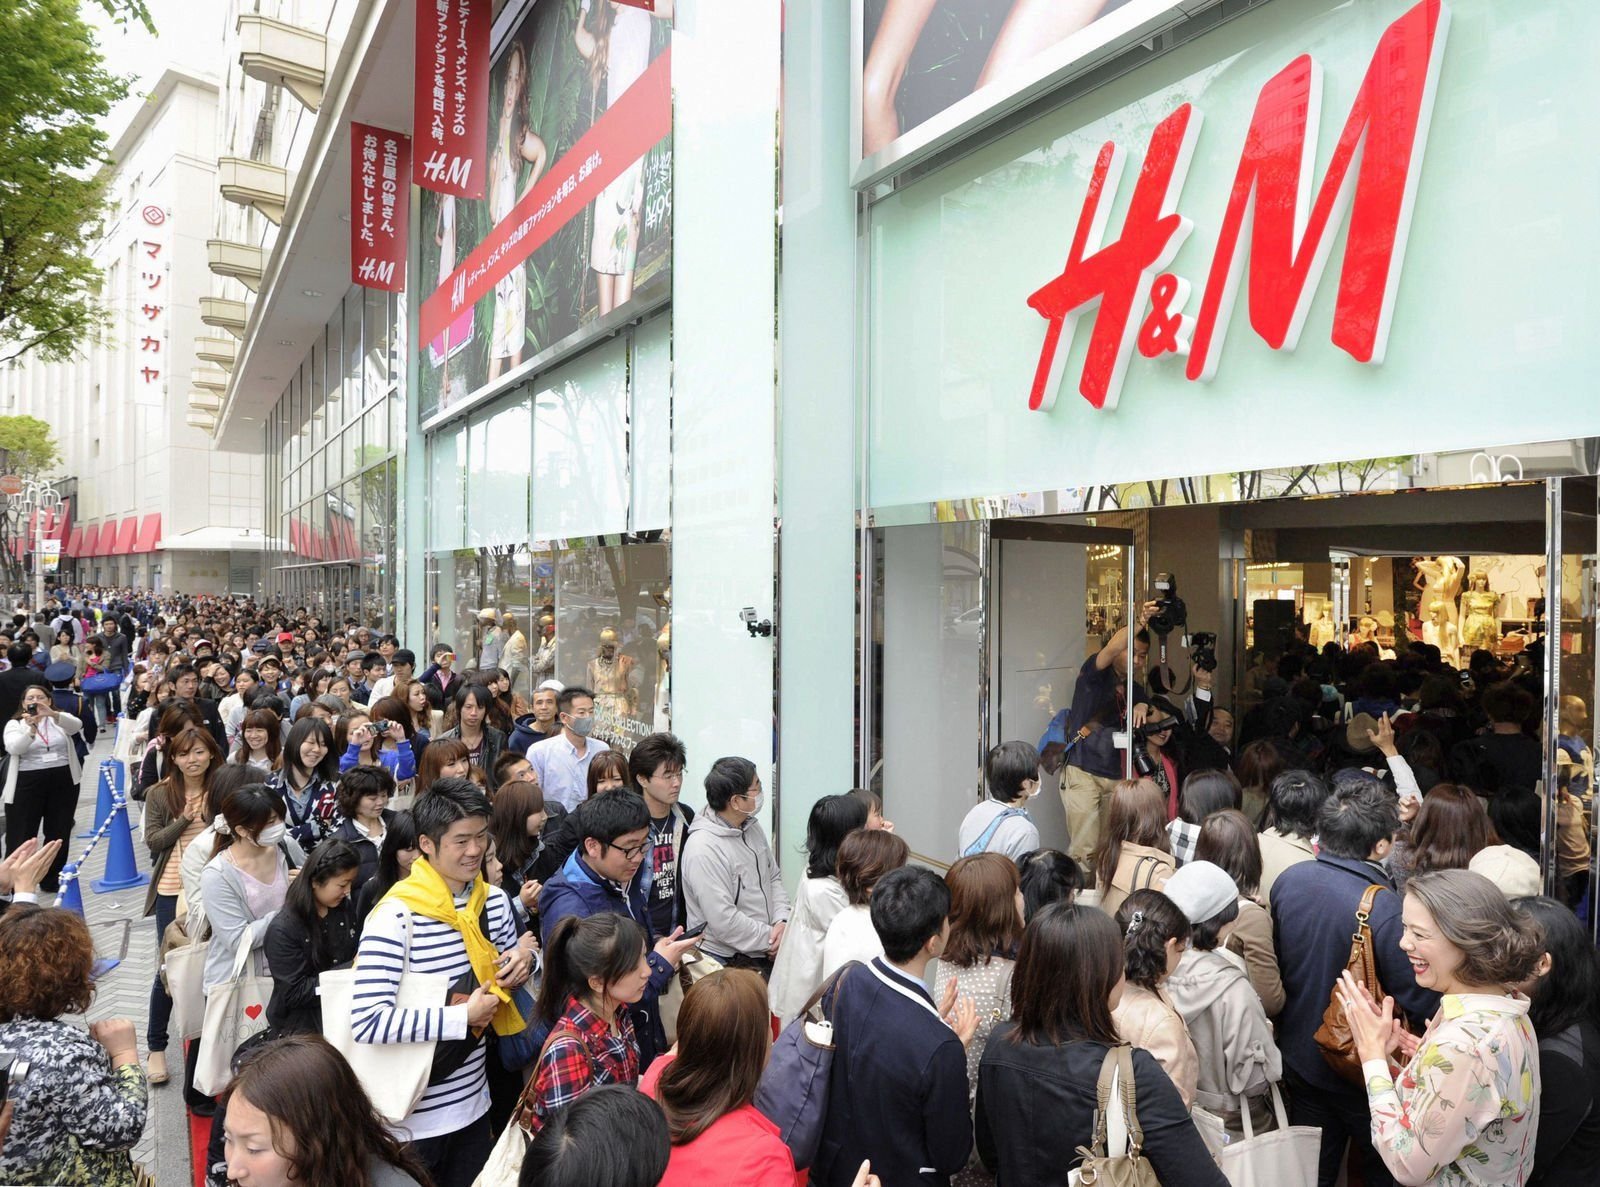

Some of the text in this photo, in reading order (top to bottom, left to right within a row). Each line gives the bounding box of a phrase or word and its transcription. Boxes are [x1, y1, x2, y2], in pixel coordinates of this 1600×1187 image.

[360, 134, 378, 248] お待たせしました。
[380, 139, 398, 239] 名古屋の皆さん、
[423, 150, 473, 190] H&M
[1026, 0, 1449, 412] H&M
[140, 240, 164, 385] マツザカヤ
[358, 257, 396, 286] H&M
